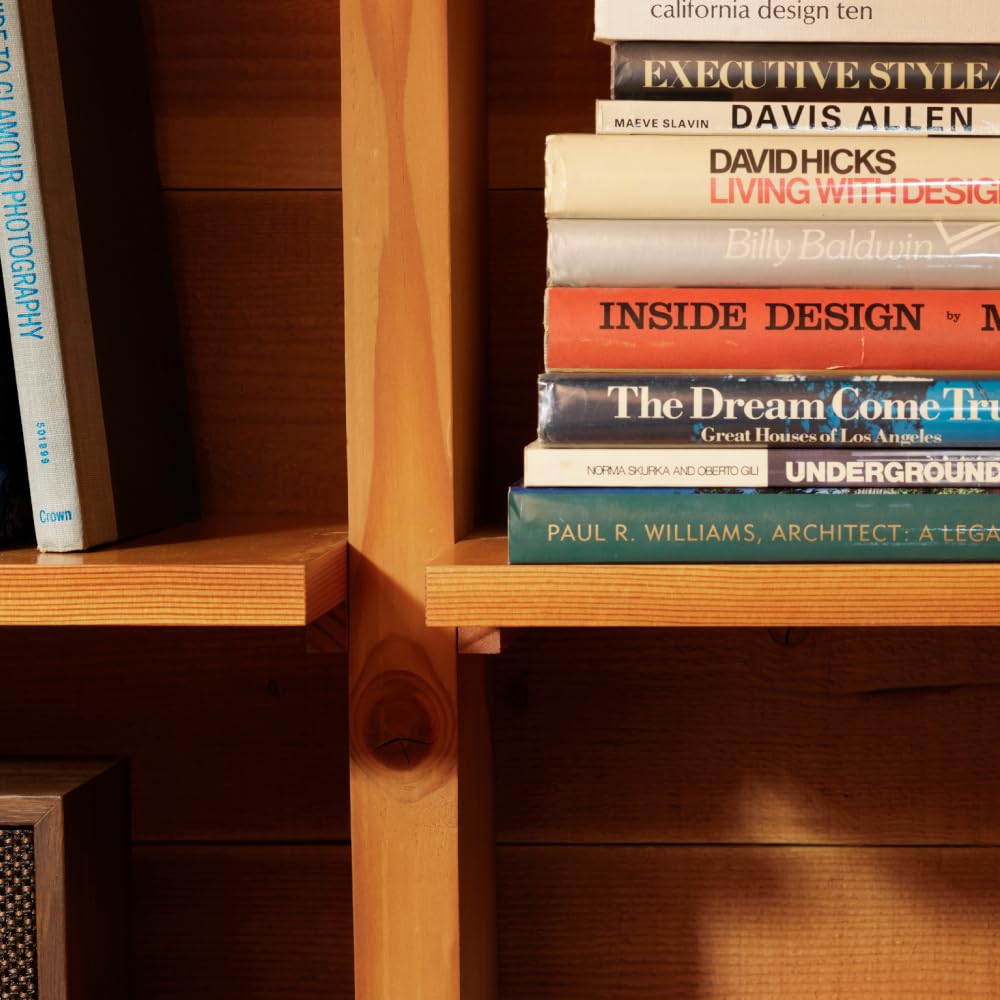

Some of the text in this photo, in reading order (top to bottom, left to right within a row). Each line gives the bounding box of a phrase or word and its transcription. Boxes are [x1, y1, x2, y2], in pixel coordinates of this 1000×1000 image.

[650, 0, 874, 25] california design ten
[642, 59, 859, 90] EXECUTIVE
[614, 118, 709, 129] MAEVE SLAVIN
[731, 104, 974, 132] DAVIS ALLEN
[710, 177, 811, 204] LIVING
[816, 178, 897, 204] WITH
[724, 227, 792, 268] Billy
[799, 227, 933, 261] Baldwin
[2, 190, 44, 340] PHOTOGRAPHY
[599, 302, 747, 330] INSIDE
[765, 303, 925, 331] DESIGN
[946, 310, 961, 322] by
[607, 386, 683, 419] The
[690, 386, 826, 420] Dream
[832, 386, 940, 421] Come
[701, 427, 942, 446] Great Houses of Los Angeles
[587, 465, 759, 476] NORMA SKURKA AND OBERTO GILI
[39, 509, 72, 523] Crown
[547, 524, 607, 542] PAUL
[615, 524, 635, 542] R.
[644, 524, 762, 545] WILLIAMS,
[771, 524, 909, 543] ARCHITECT:
[919, 524, 934, 543] A
